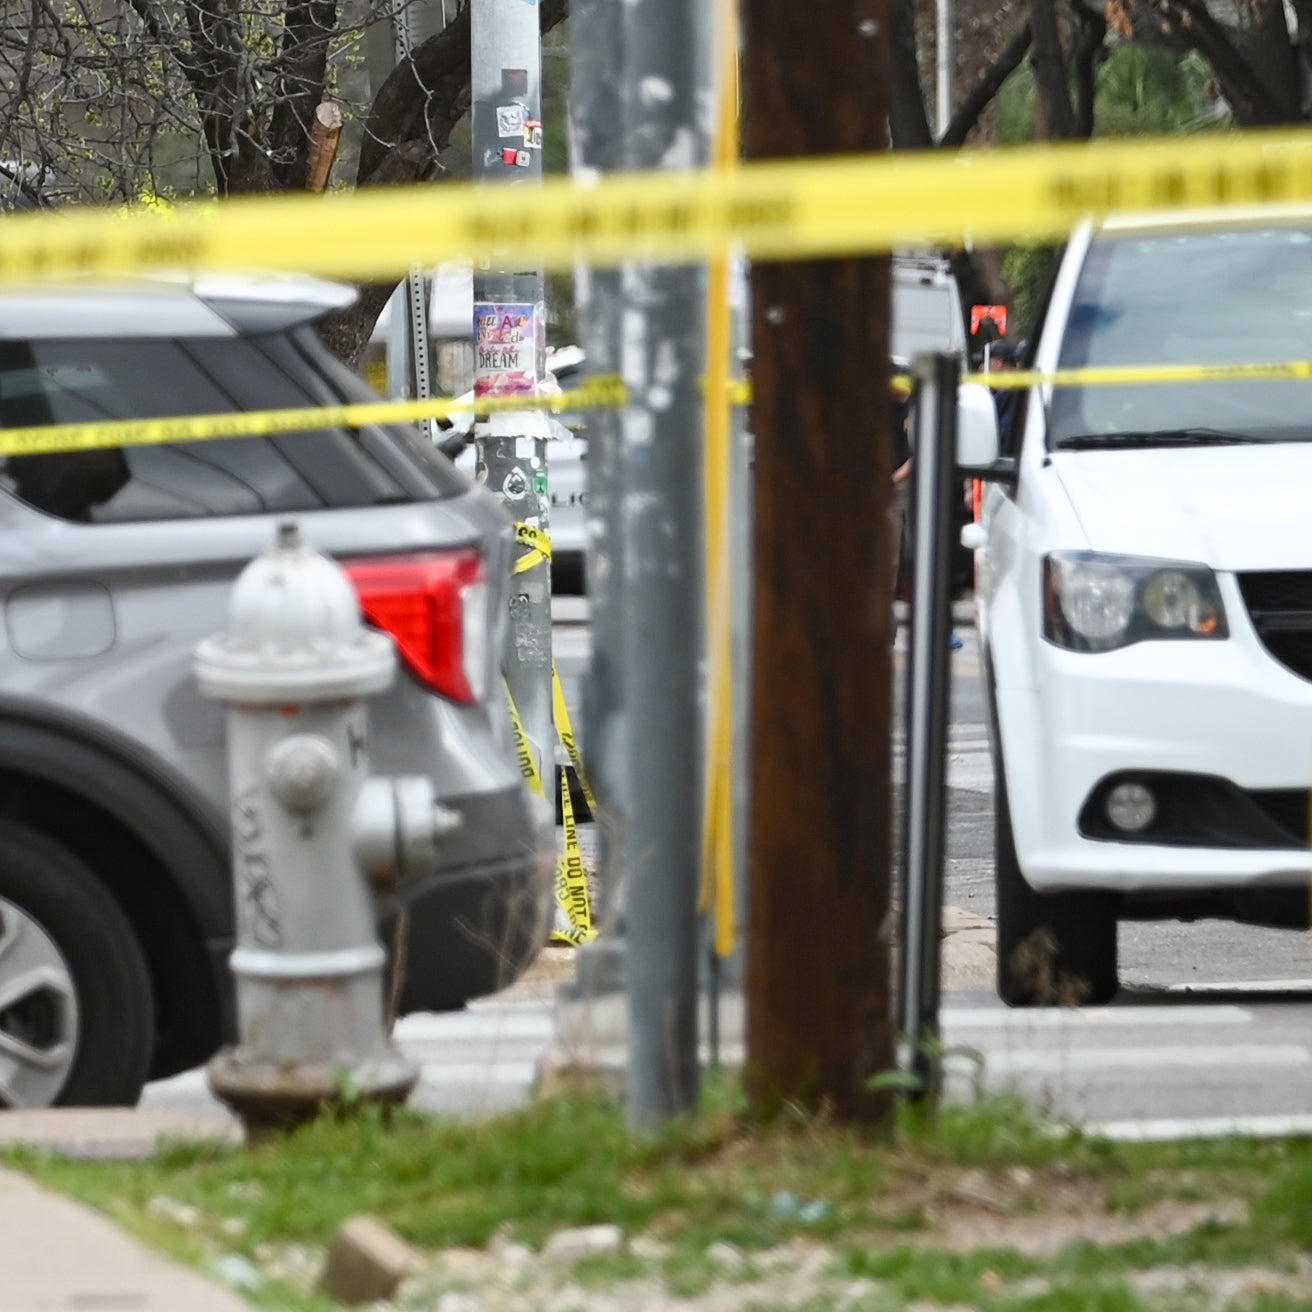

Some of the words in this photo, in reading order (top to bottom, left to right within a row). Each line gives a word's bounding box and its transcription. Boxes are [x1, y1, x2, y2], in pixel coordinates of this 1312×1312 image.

[479, 352, 518, 369] DREAM
[565, 815, 578, 850] LINE
[566, 856, 583, 879] DO
[569, 885, 588, 918] NOT
